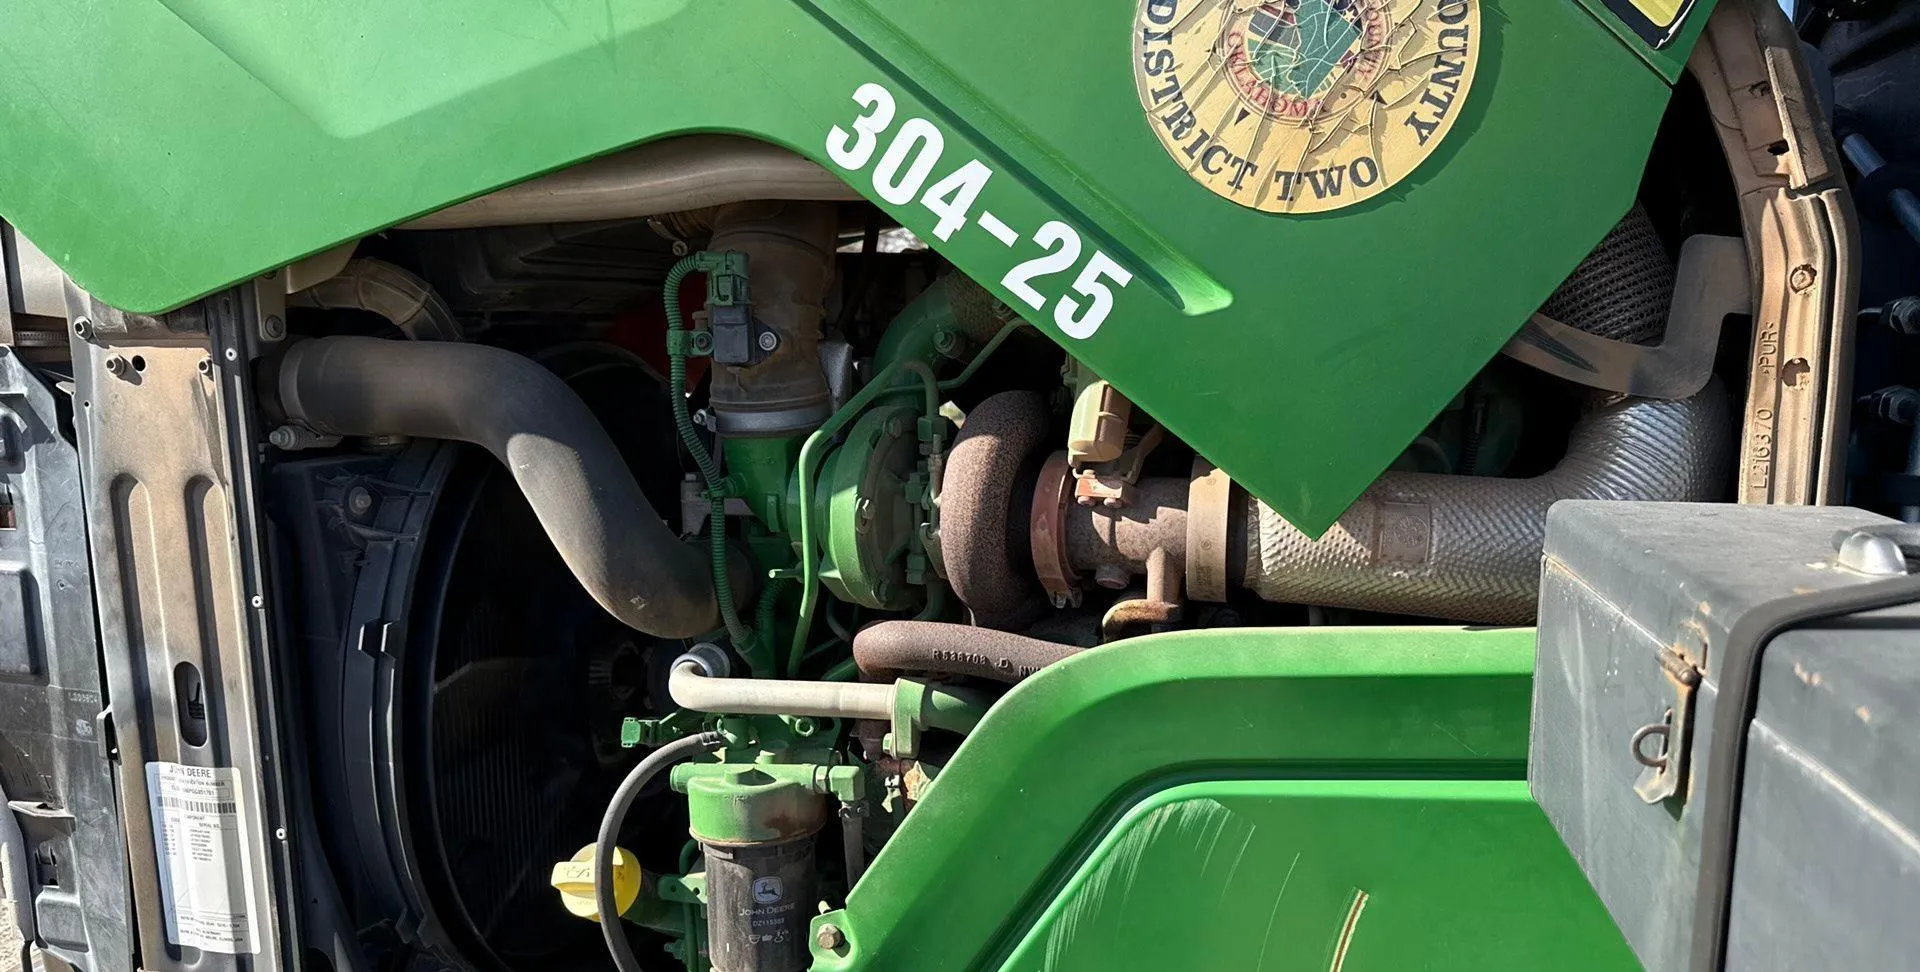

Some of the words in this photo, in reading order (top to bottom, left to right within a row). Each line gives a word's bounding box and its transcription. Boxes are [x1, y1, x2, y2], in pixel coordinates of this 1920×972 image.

[1143, 0, 1258, 191] DISTRICT
[1274, 156, 1379, 201] TWO
[825, 82, 1134, 340] 304-25
[1751, 408, 1773, 489] L216370
[187, 768, 212, 779] DEERE
[740, 907, 765, 917] JOHN
[766, 903, 796, 914] DEERE
